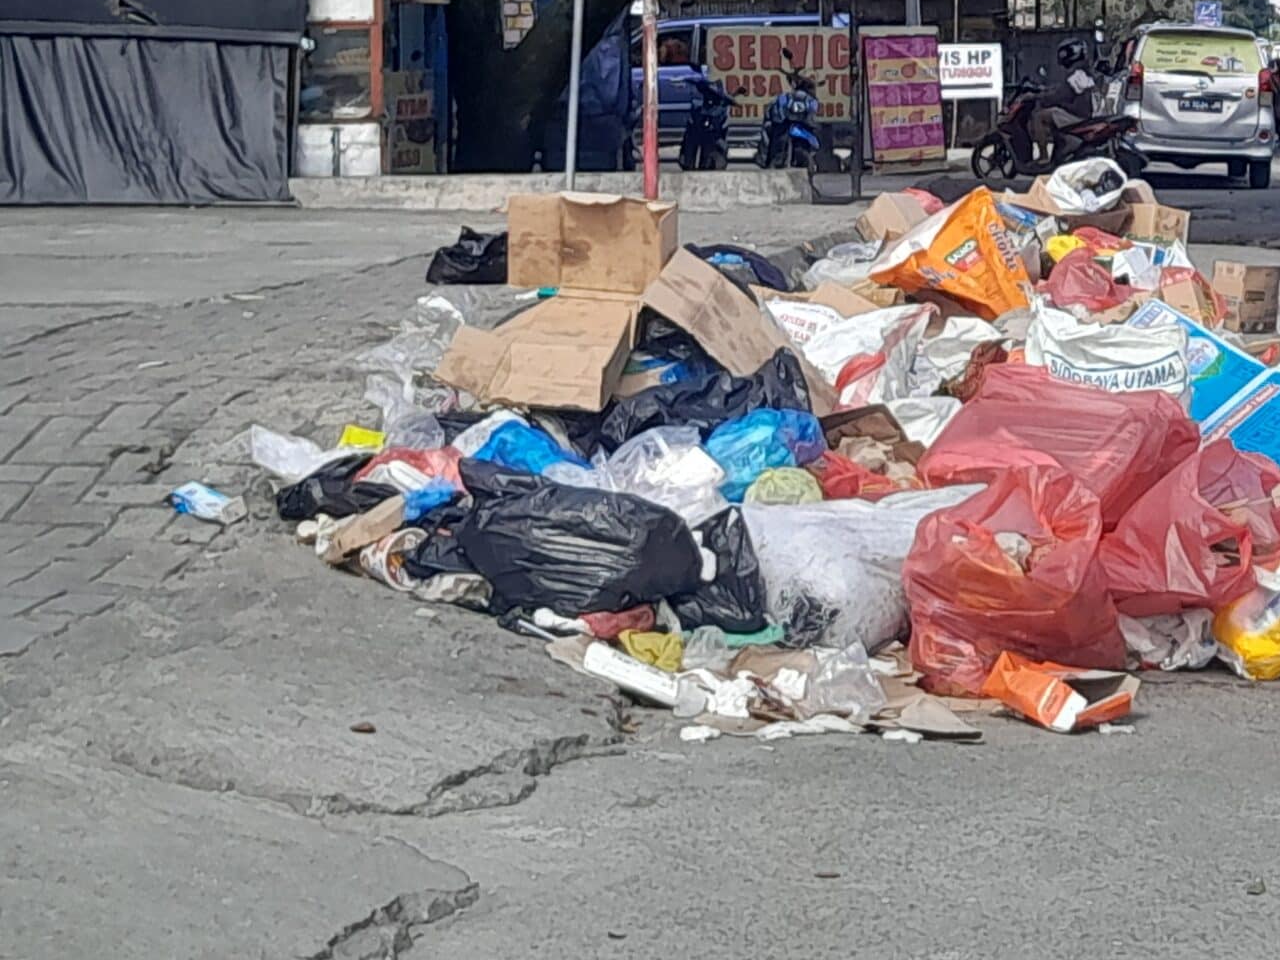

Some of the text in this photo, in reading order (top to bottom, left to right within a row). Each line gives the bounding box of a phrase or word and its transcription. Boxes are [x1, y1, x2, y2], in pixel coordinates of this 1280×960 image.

[713, 32, 850, 72] SERVIC
[967, 49, 992, 65] HP
[1124, 361, 1177, 389] UTAMA
